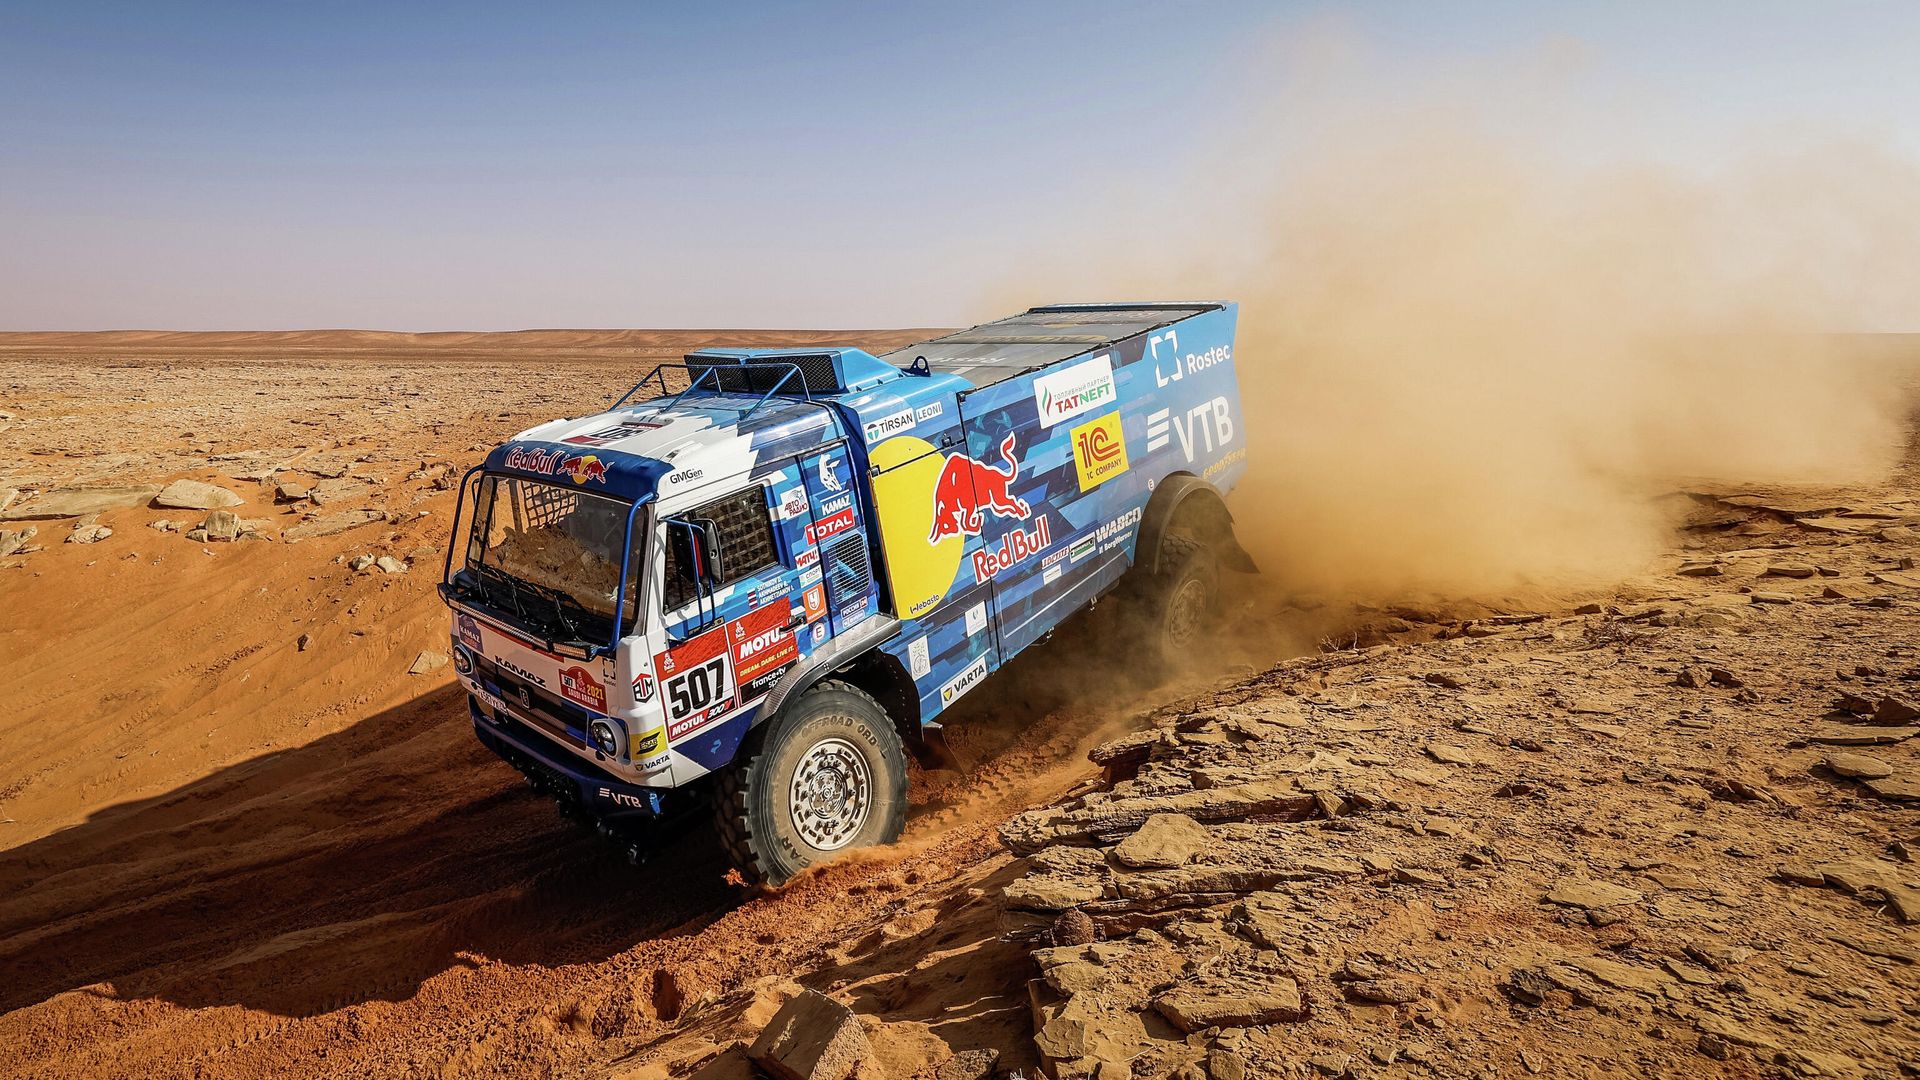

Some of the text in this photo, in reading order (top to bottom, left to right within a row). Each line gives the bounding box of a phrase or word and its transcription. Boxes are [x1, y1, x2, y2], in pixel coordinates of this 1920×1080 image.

[1186, 344, 1231, 375] Rostec
[1055, 383, 1111, 414] TATNEFT
[917, 403, 941, 419] LEONI
[1172, 395, 1234, 463] VTB
[1095, 457, 1122, 476] COMPANY
[821, 495, 851, 516] KAMAZ
[807, 516, 853, 540] TOTAL
[1095, 507, 1142, 543] WABCO
[972, 513, 1052, 586] Red Bull
[1042, 547, 1069, 569] LOCTITE
[910, 594, 940, 615] Webasto
[740, 625, 788, 660] MOTUL
[495, 655, 547, 688] KAMAZ
[953, 664, 985, 693] VARTA
[586, 684, 604, 700] 2021
[667, 657, 724, 720] 507
[671, 714, 705, 737] MOTUL
[644, 754, 670, 769] VARTA
[610, 792, 642, 808] VTB
